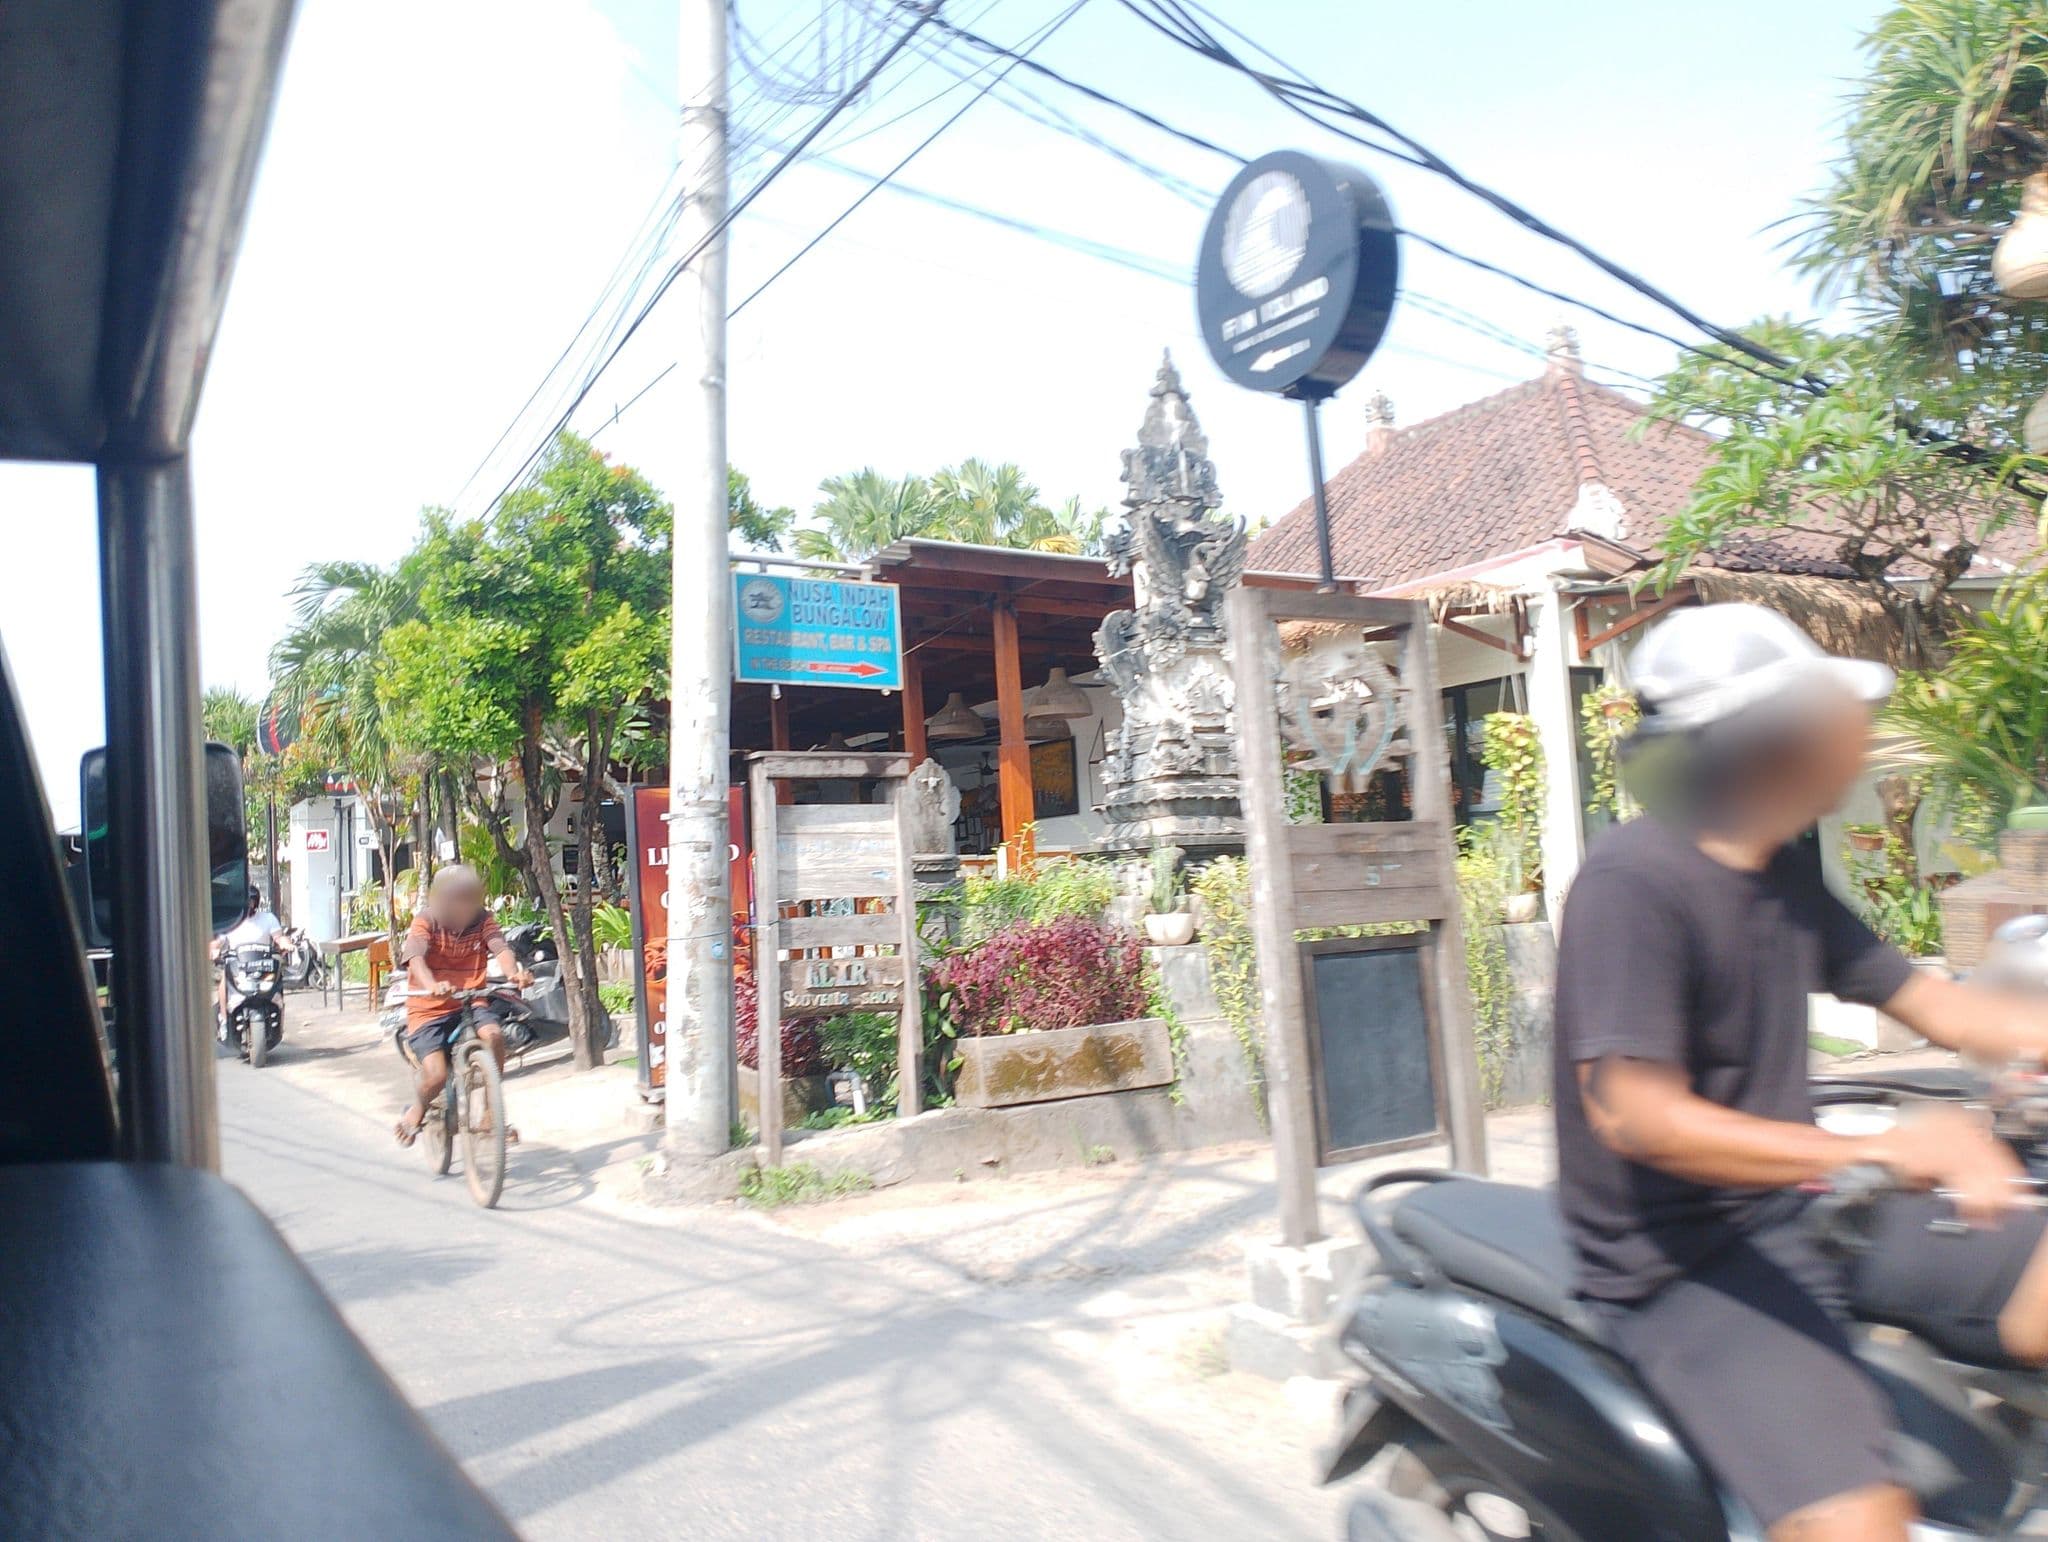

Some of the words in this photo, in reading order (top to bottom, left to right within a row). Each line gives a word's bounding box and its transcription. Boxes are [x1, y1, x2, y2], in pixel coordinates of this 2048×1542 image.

[788, 581, 833, 604] NUSA
[841, 585, 889, 609] INDAH
[792, 604, 887, 629] BUNGALOW
[869, 636, 891, 654] SPA
